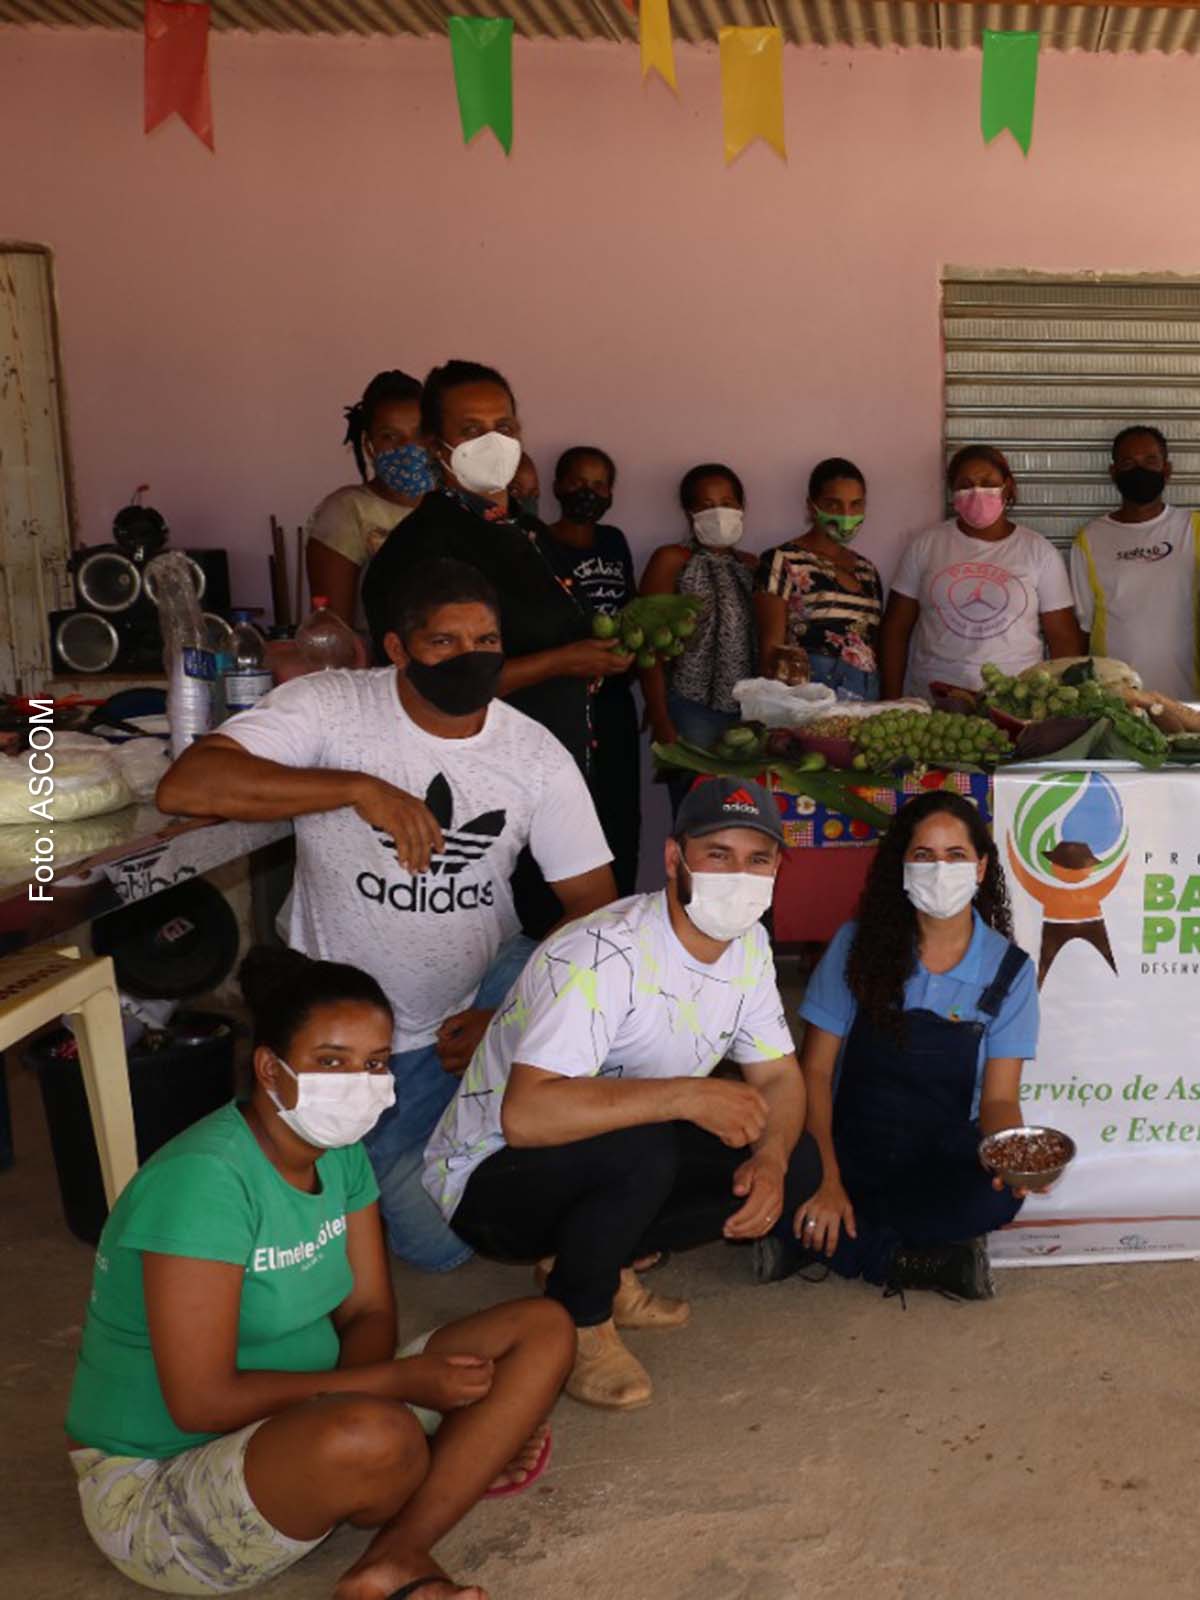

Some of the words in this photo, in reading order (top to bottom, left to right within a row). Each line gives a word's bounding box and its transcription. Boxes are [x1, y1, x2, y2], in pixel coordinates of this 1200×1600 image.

[722, 802, 760, 815] adidas
[356, 871, 495, 914] adidas
[1018, 1075, 1113, 1107] erviço
[1122, 1074, 1159, 1101] de
[1101, 1122, 1118, 1143] e
